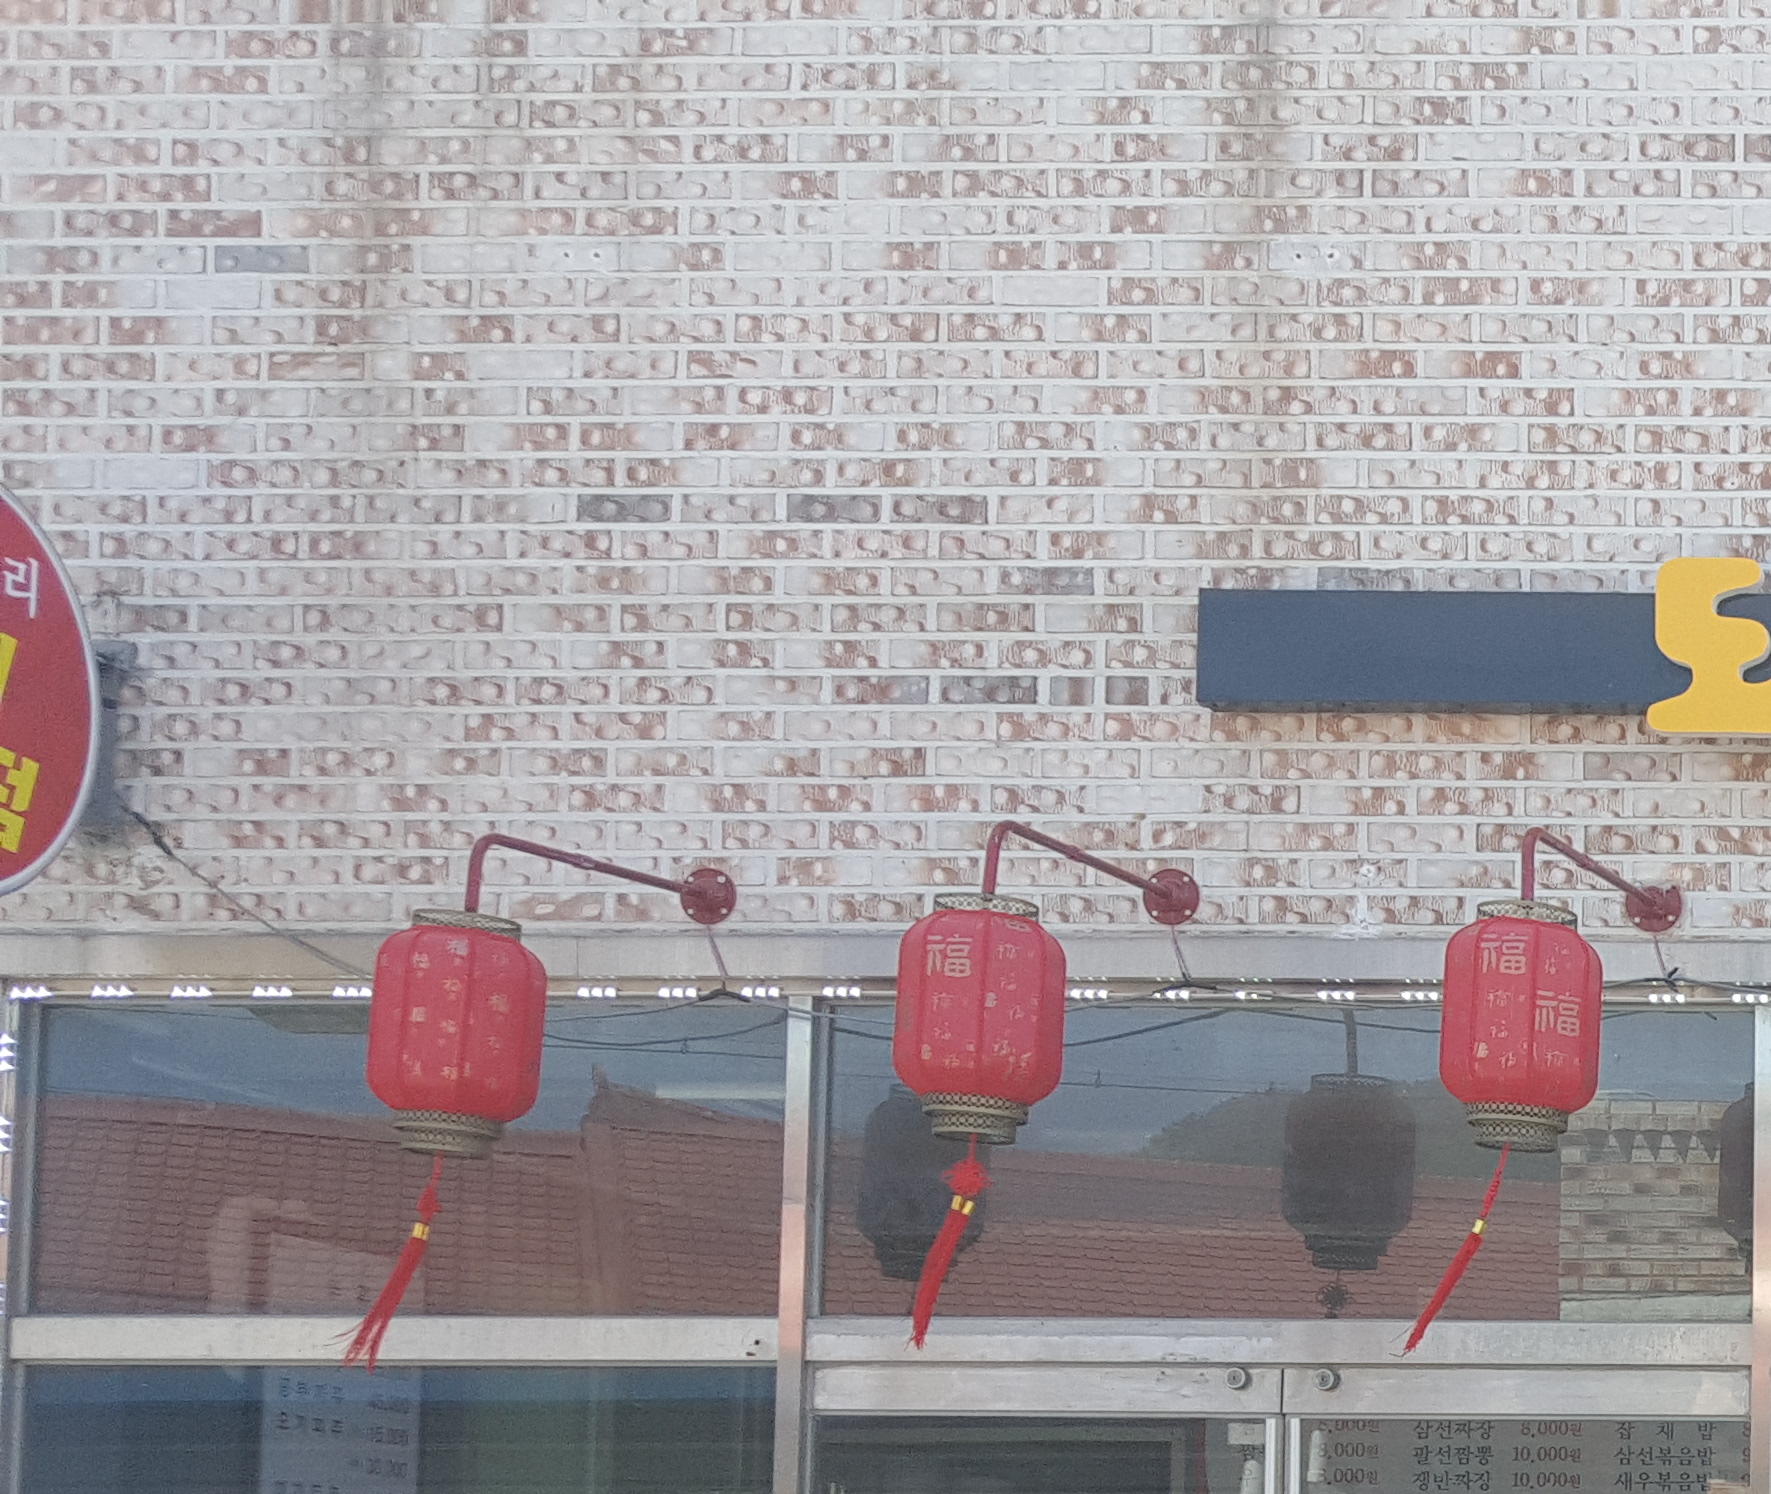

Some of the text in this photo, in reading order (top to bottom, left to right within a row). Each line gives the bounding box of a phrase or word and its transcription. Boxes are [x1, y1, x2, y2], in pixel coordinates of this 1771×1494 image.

[926, 933, 973, 978] 福
[1480, 933, 1529, 975] 福
[1535, 989, 1581, 1037] 福
[1412, 1445, 1494, 1466] 팔선짬뽕
[1613, 1446, 1716, 1466] 삼선볶음밥
[1412, 1470, 1491, 1492] 쟁반짜장
[1614, 1471, 1715, 1492] 새우볶음밥
